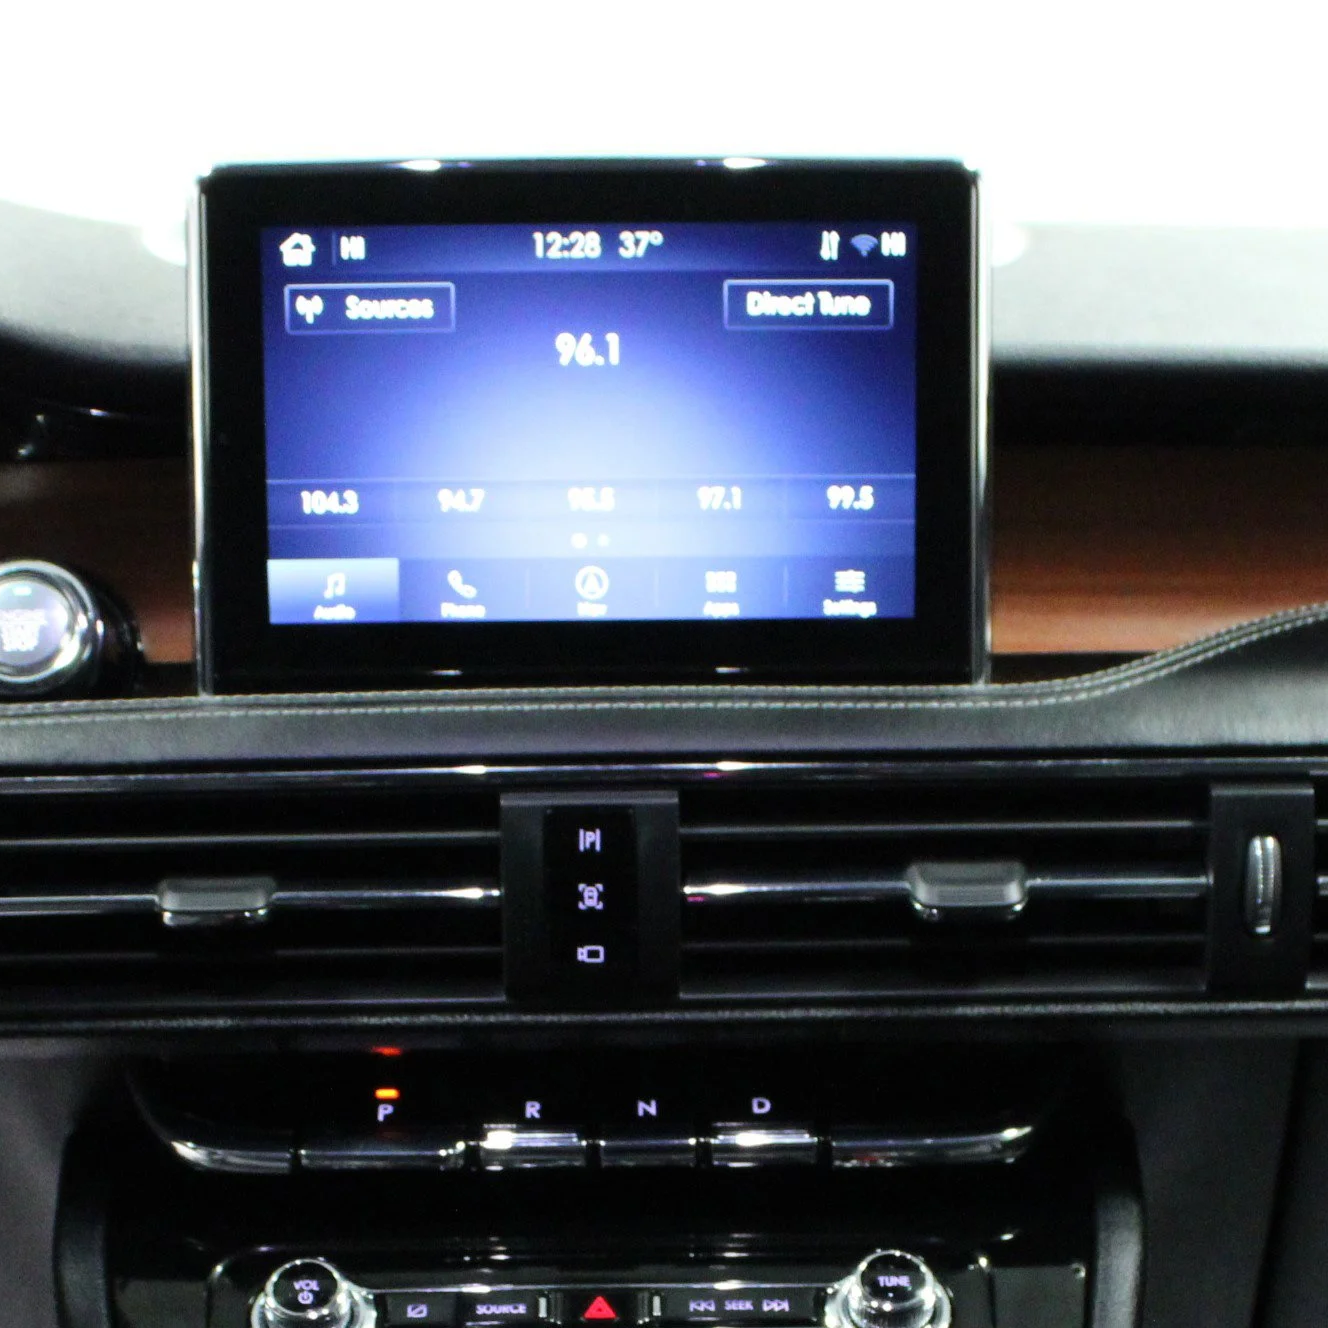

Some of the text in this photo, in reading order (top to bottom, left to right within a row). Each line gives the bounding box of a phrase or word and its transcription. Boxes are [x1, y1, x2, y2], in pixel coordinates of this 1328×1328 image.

[533, 231, 602, 259] 12:28
[345, 295, 435, 320] Sources
[746, 290, 871, 316] Direct Tune
[555, 332, 620, 367] 96.1
[301, 489, 359, 515] 104.3
[437, 488, 485, 512] 94.7
[697, 485, 742, 510] 97.1
[827, 485, 874, 510] 99.5
[377, 1104, 394, 1122] P
[525, 1101, 541, 1118] R
[637, 1100, 657, 1117] N
[752, 1097, 771, 1114] D
[293, 1280, 320, 1292] VOL
[877, 1275, 911, 1288] TUNE
[476, 1303, 527, 1315] SOURCE
[724, 1299, 754, 1311] SEEK
